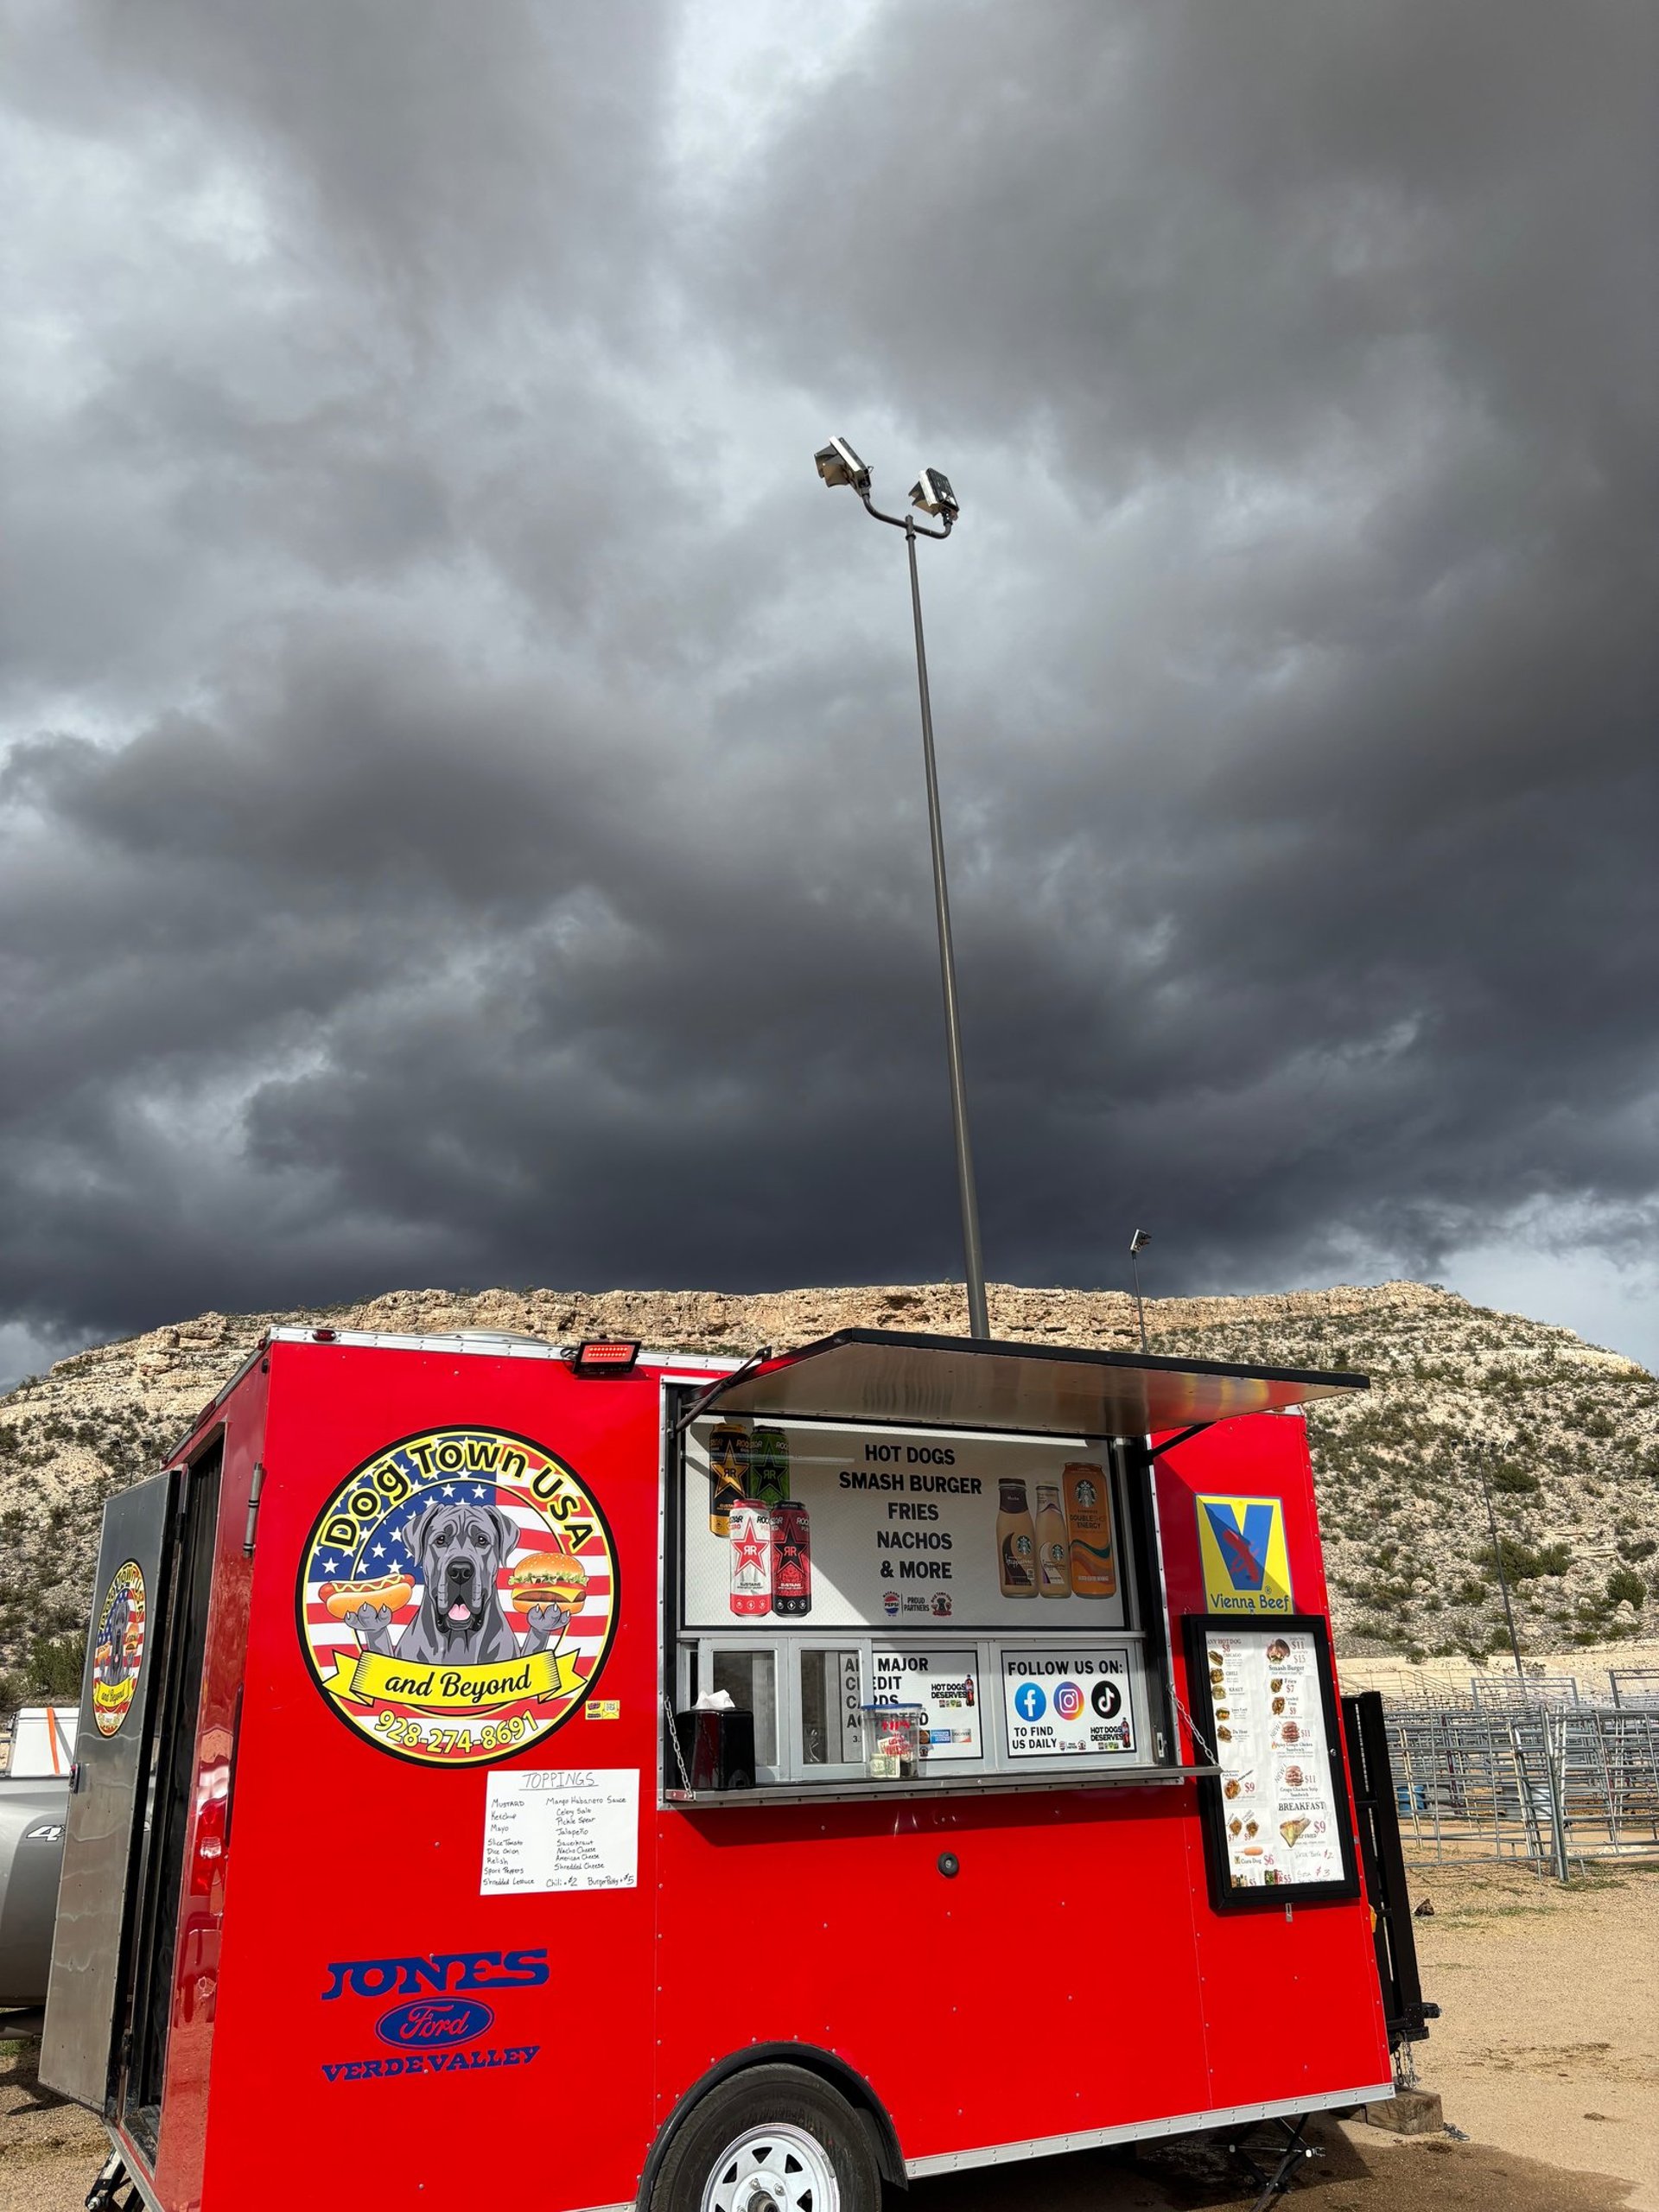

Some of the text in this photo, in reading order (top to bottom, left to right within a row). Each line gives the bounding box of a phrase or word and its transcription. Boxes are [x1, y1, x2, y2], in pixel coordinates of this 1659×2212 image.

[865, 1444, 955, 1466] HOT DOGS
[839, 1471, 982, 1495] SMASH BURGER
[321, 1438, 596, 1551] Dog Town USA
[887, 1502, 939, 1522] FRIES
[876, 1530, 953, 1551] NACHOS
[880, 1560, 952, 1580] & MORE
[1211, 1593, 1289, 1611] Vienna Beef
[878, 1657, 929, 1671] MAJOR
[1007, 1660, 1123, 1676] FOLLOW US ON:
[385, 1665, 532, 1705] and Beyond
[1286, 1684, 1294, 1693] $7
[373, 1708, 540, 1754] 928-274-8691
[1014, 1726, 1053, 1737] TO FIND
[1013, 1739, 1026, 1749] US
[1028, 1738, 1057, 1749] DAILY
[523, 1772, 594, 1789] TOPPINGS
[1244, 1782, 1255, 1793] $9
[546, 1797, 569, 1807] Mango
[1279, 1802, 1325, 1812] BREAKFAST
[556, 1808, 574, 1816] Celery
[490, 1825, 509, 1834] Mayo
[1314, 1821, 1326, 1834] $9
[503, 1866, 524, 1875] Peppers
[546, 1878, 563, 1887] Chili
[321, 1948, 550, 2000] JONES
[399, 2005, 471, 2040] Ford
[321, 2045, 541, 2082] VERDE VALLEY
